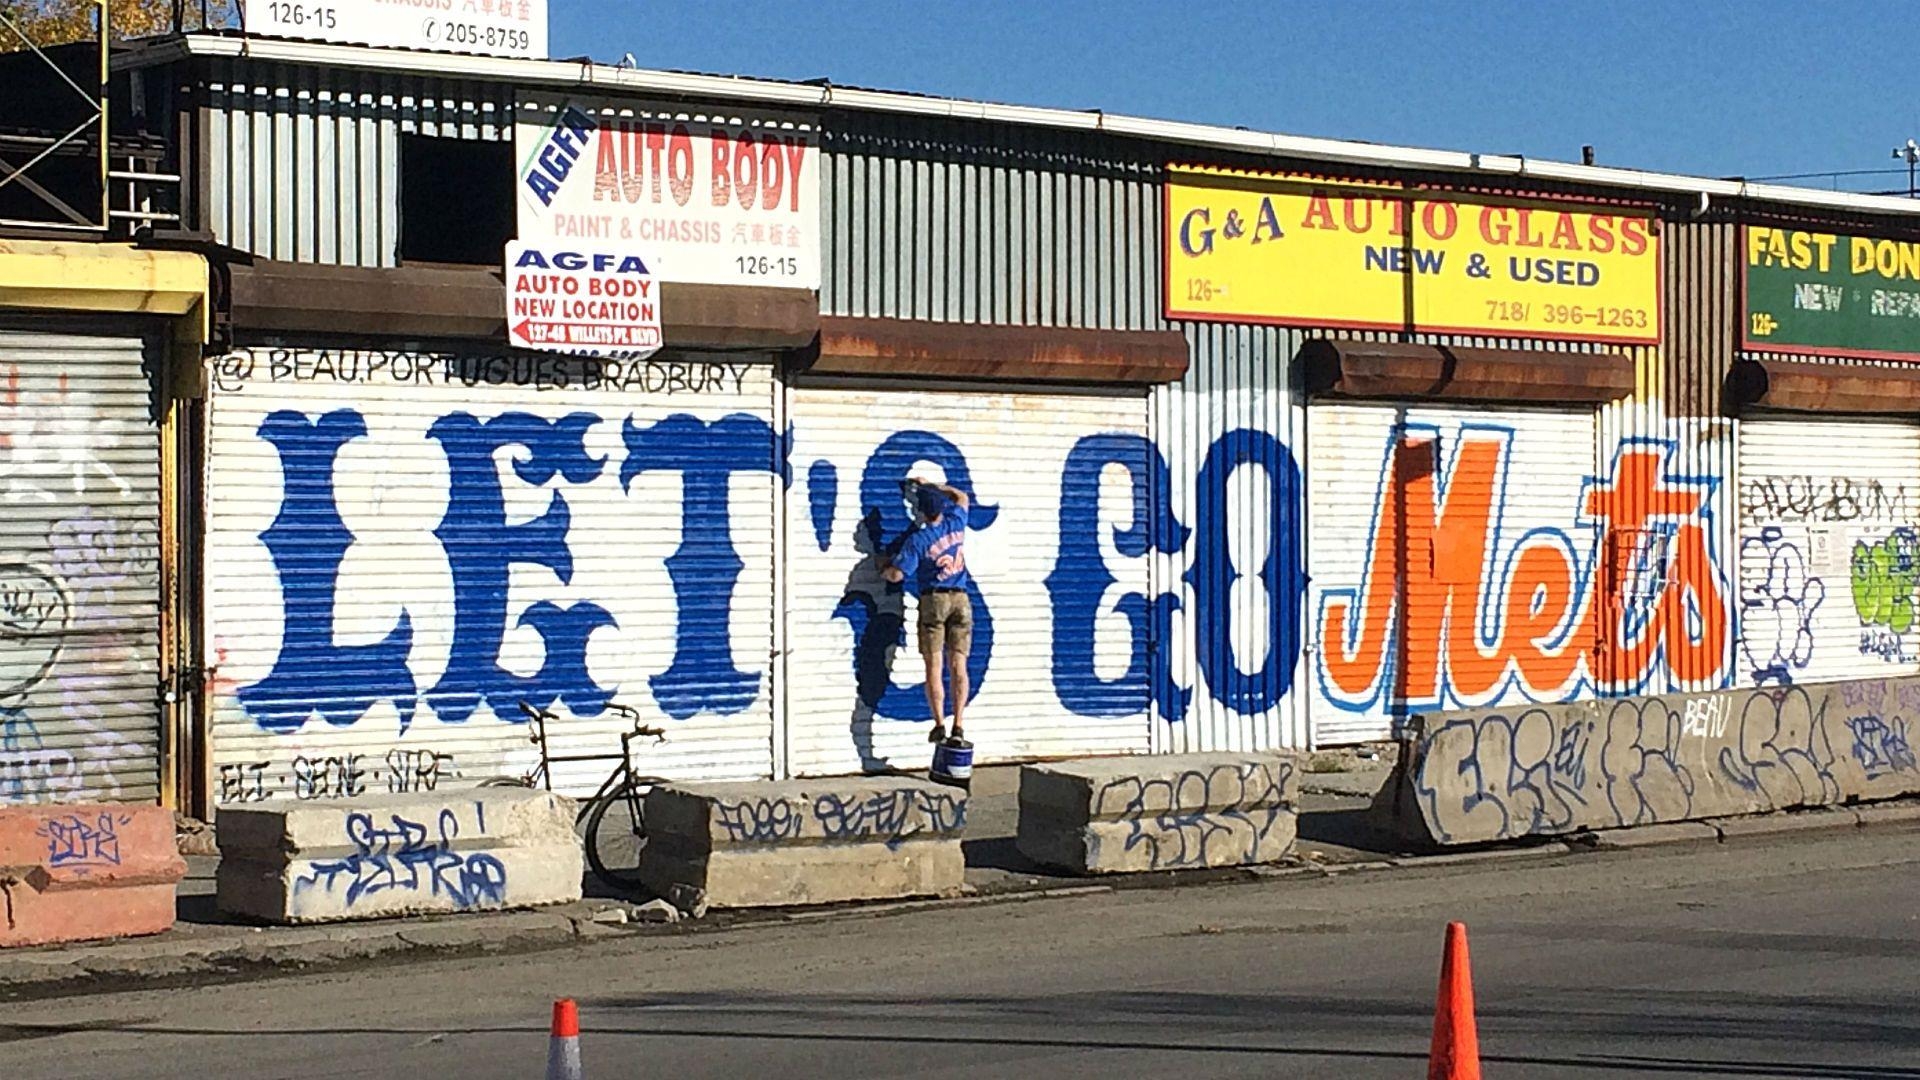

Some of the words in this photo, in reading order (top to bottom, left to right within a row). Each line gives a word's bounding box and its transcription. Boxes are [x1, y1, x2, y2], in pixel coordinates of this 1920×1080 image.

[525, 105, 598, 208] AGFA
[593, 119, 694, 207] AUTO
[711, 128, 807, 212] BODY
[554, 213, 612, 238] PAINT
[620, 217, 632, 239] &
[640, 217, 721, 244] CHASSIS
[1301, 189, 1458, 241] AUTO
[1478, 203, 1649, 257] GLASS
[515, 249, 650, 274] AGFA
[1365, 245, 1445, 275] NEW
[1465, 253, 1491, 279] &
[1510, 256, 1600, 287] USED
[1748, 225, 1837, 272] FAST
[515, 274, 579, 295] AUTO
[589, 277, 650, 298] BODY
[1794, 283, 1843, 312] NEW
[515, 297, 555, 317] NEW
[563, 299, 653, 321] LOCATION
[1043, 427, 1313, 723] GO
[1316, 421, 1742, 717] Mets
